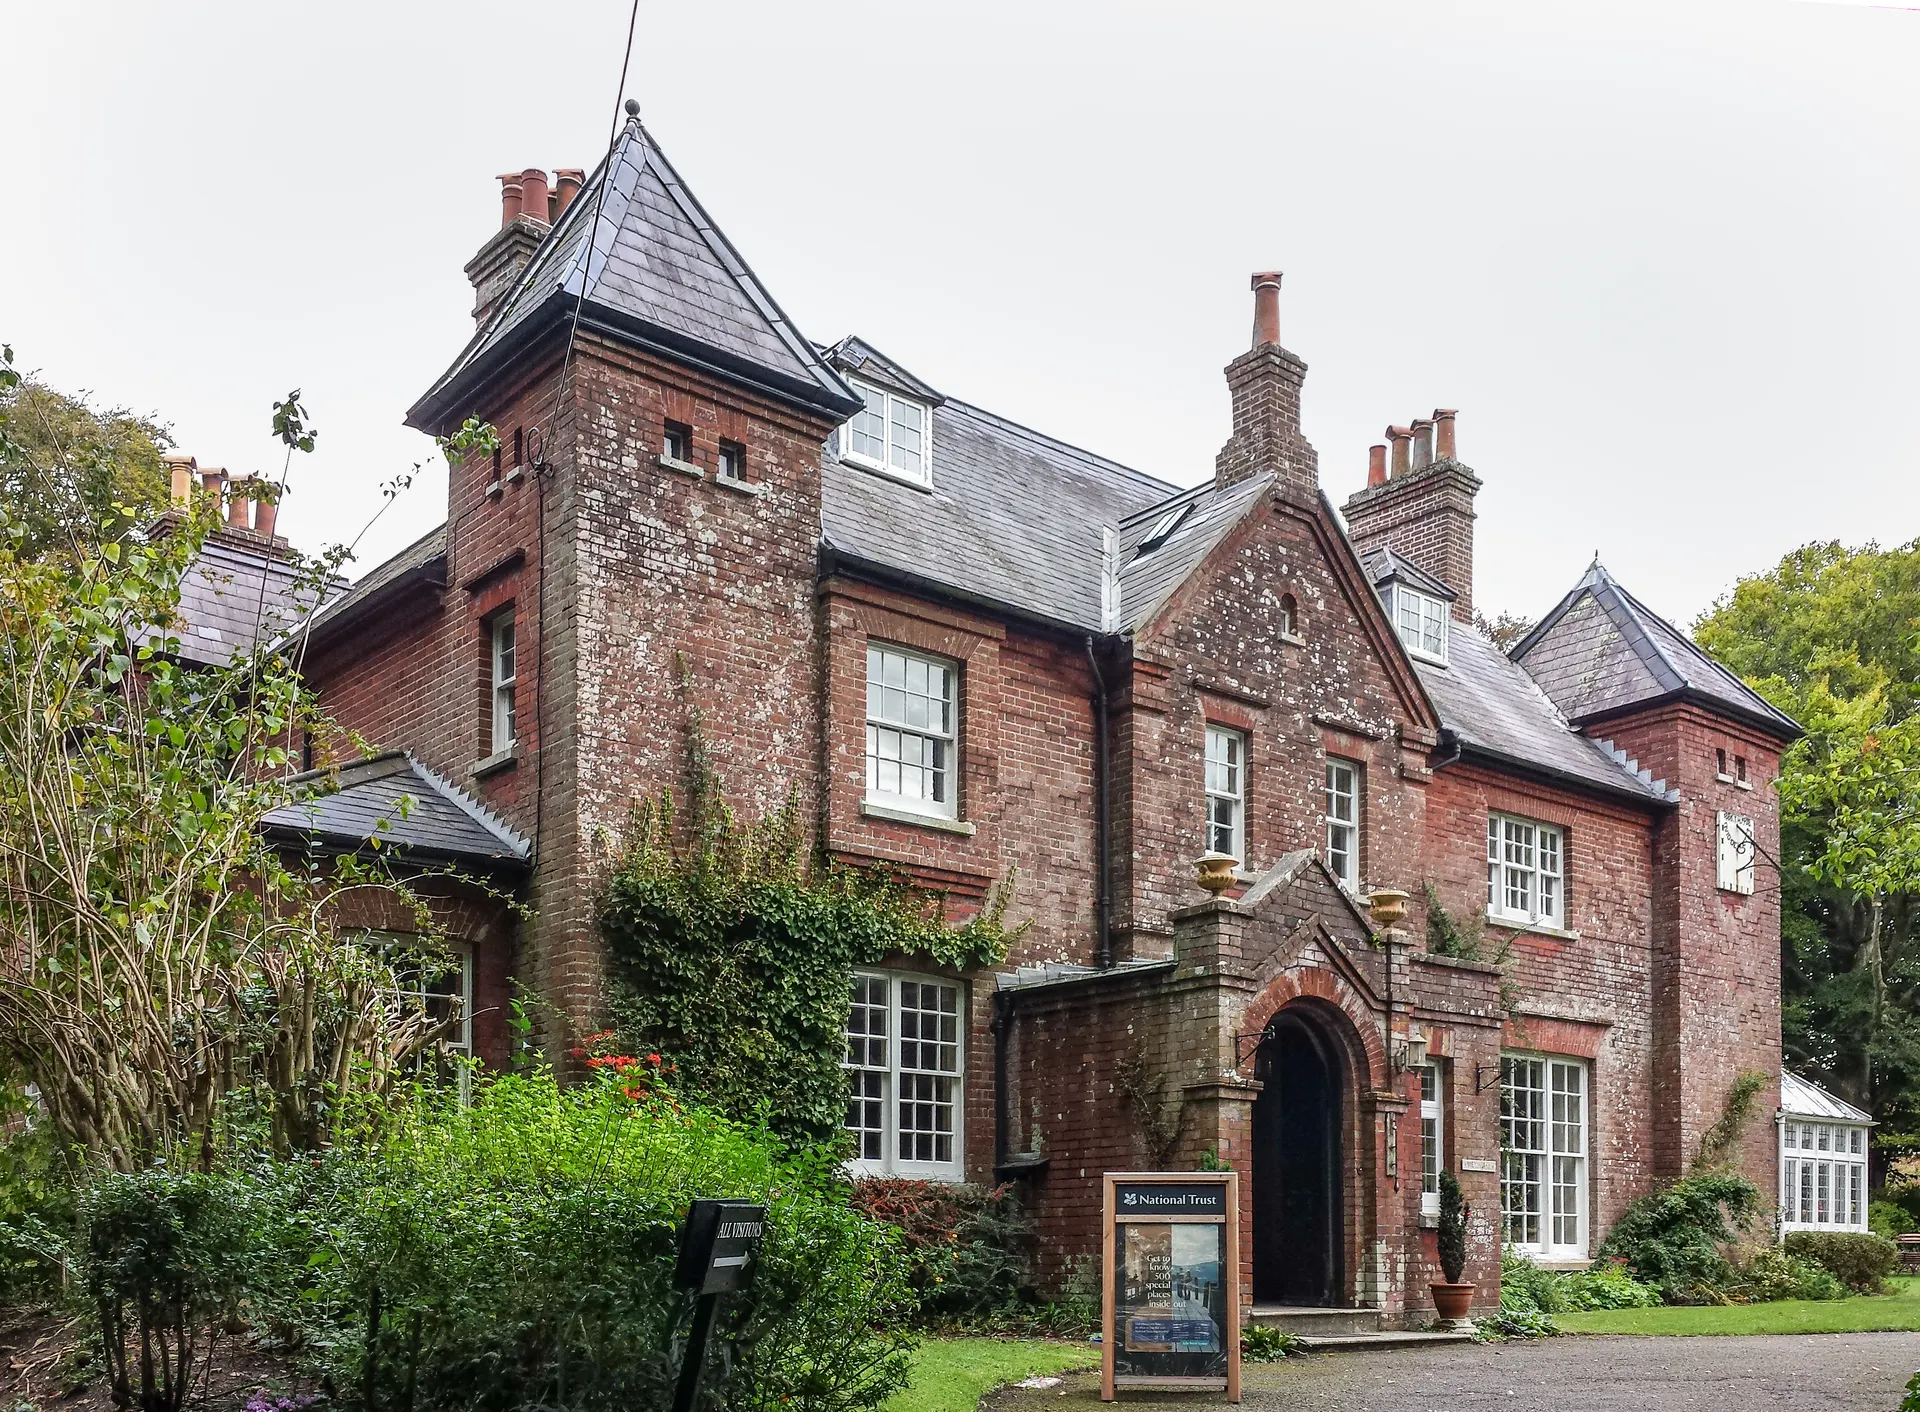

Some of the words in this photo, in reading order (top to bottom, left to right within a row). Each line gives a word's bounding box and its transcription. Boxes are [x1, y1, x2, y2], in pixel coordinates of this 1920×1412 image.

[1139, 1194, 1186, 1205] National
[1187, 1194, 1217, 1205] Trust
[717, 1222, 733, 1239] ALL
[732, 1221, 763, 1238] VISITORS
[1146, 1254, 1161, 1262] Get
[1149, 1262, 1170, 1271] know
[1154, 1272, 1171, 1280] 500
[1145, 1281, 1171, 1291] special
[1147, 1289, 1171, 1300] places
[1148, 1299, 1171, 1308] inside
[1173, 1300, 1187, 1308] out
